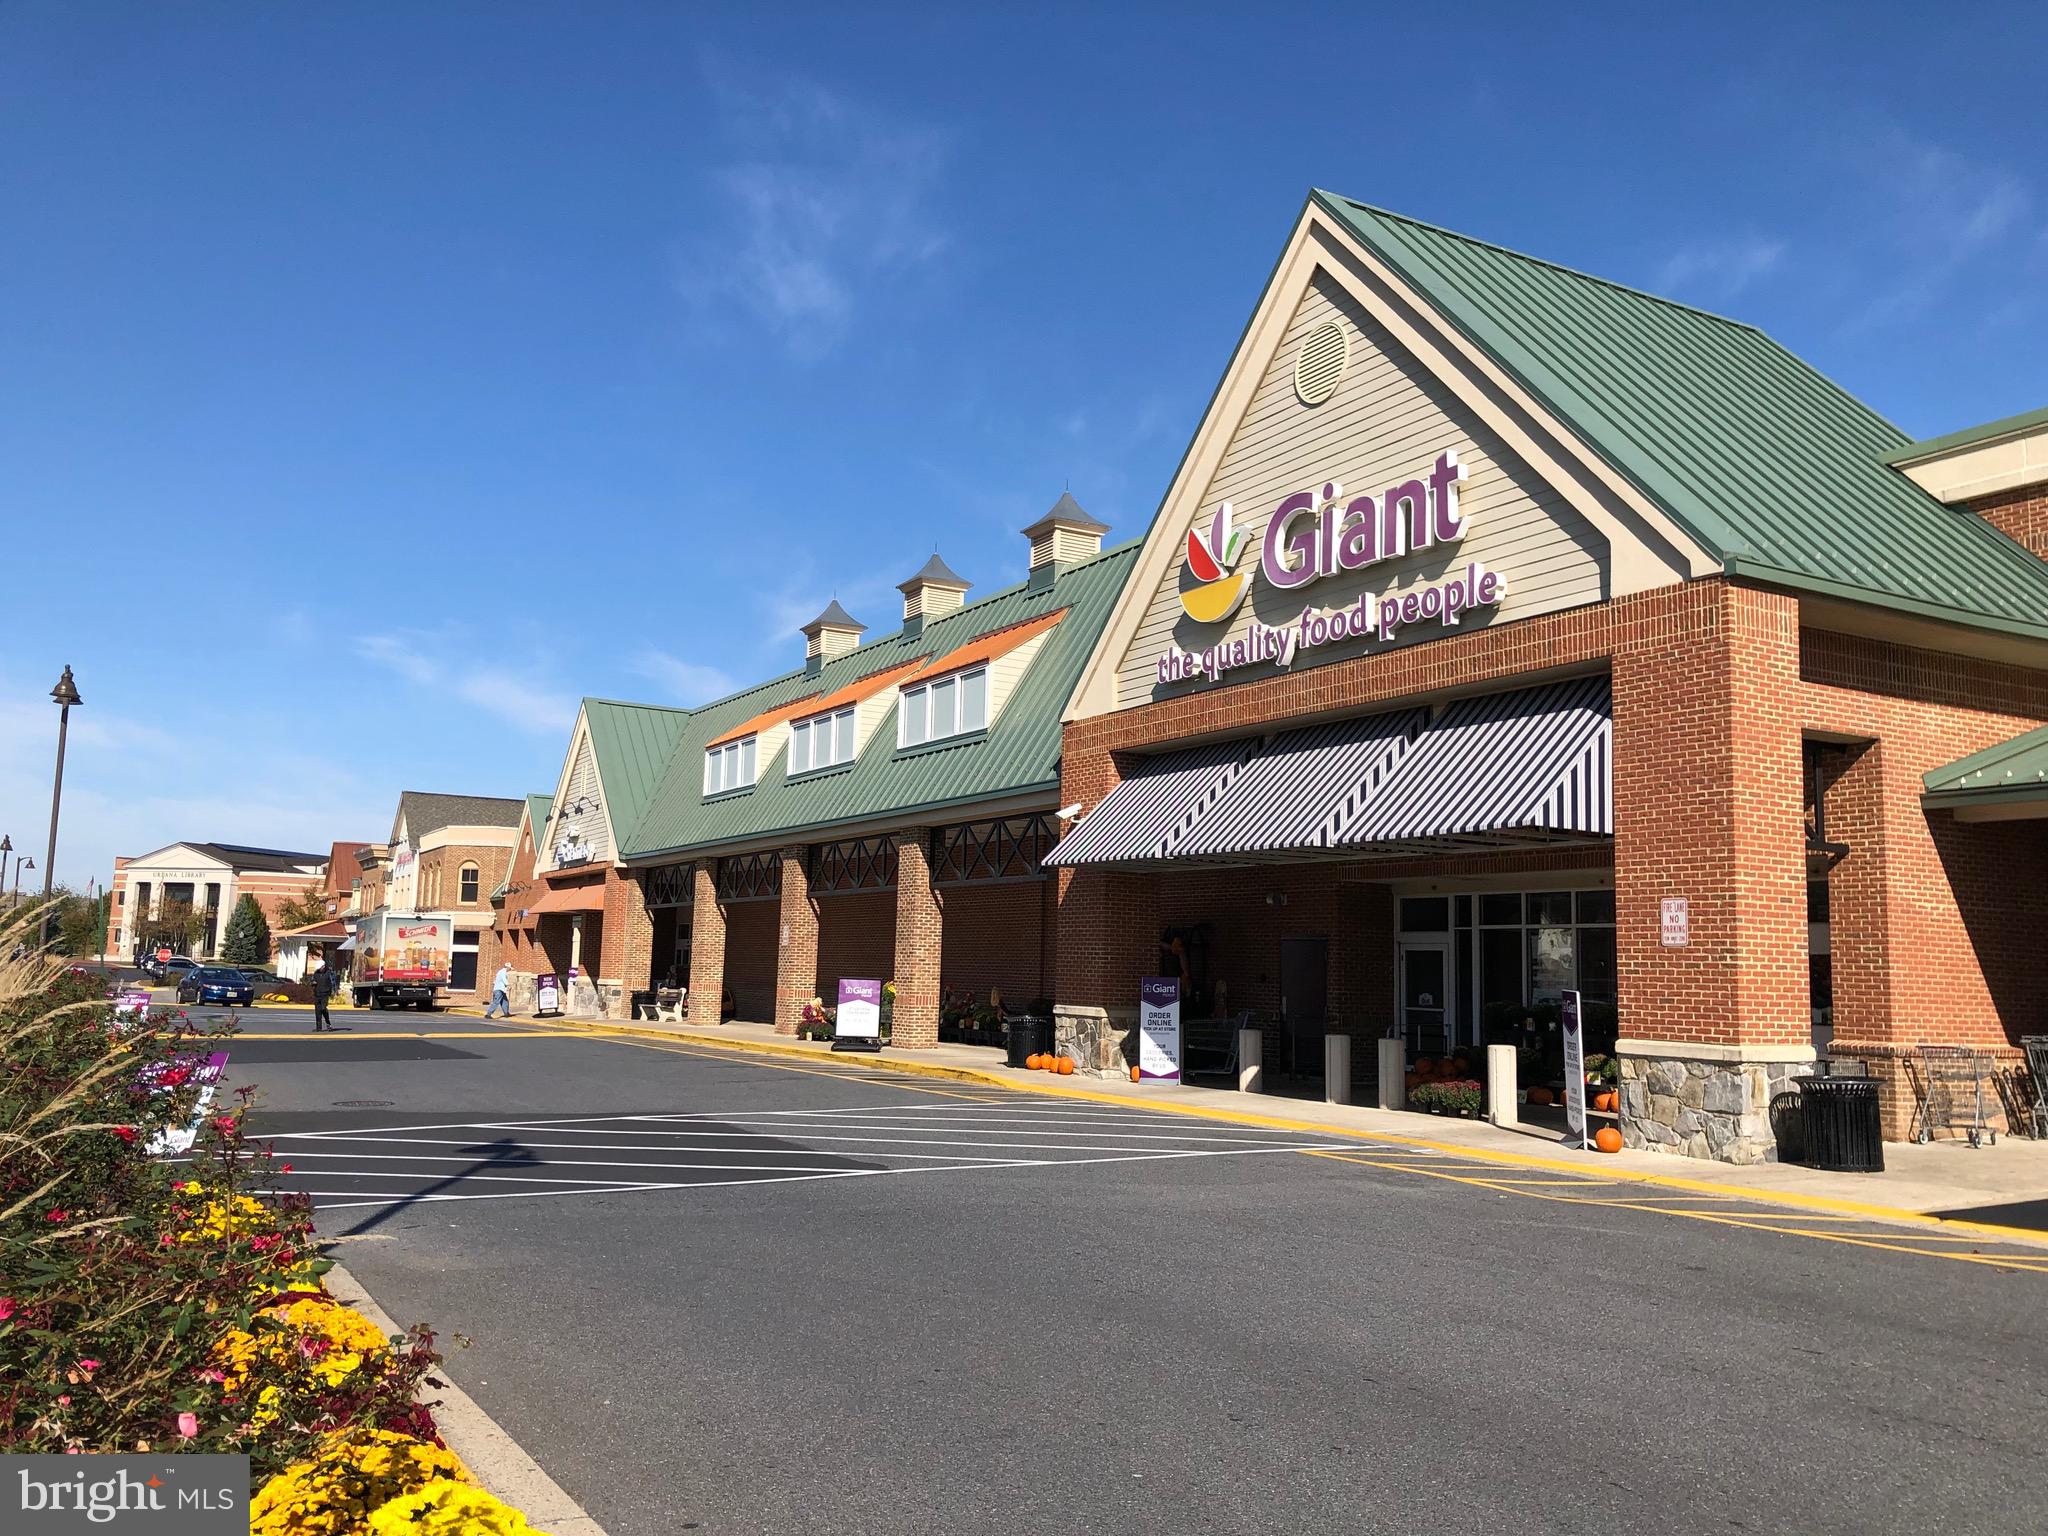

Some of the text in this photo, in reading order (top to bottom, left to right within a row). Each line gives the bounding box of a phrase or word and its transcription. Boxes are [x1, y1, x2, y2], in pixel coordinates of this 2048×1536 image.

[1261, 450, 1472, 589] Giant
[1157, 562, 1508, 684] the quality food people
[1669, 914, 1680, 923] NO
[1663, 925, 1685, 934] PARKING
[853, 986, 873, 995] Giant
[1152, 983, 1176, 993] Giant
[1147, 1019, 1172, 1027] ONLINE
